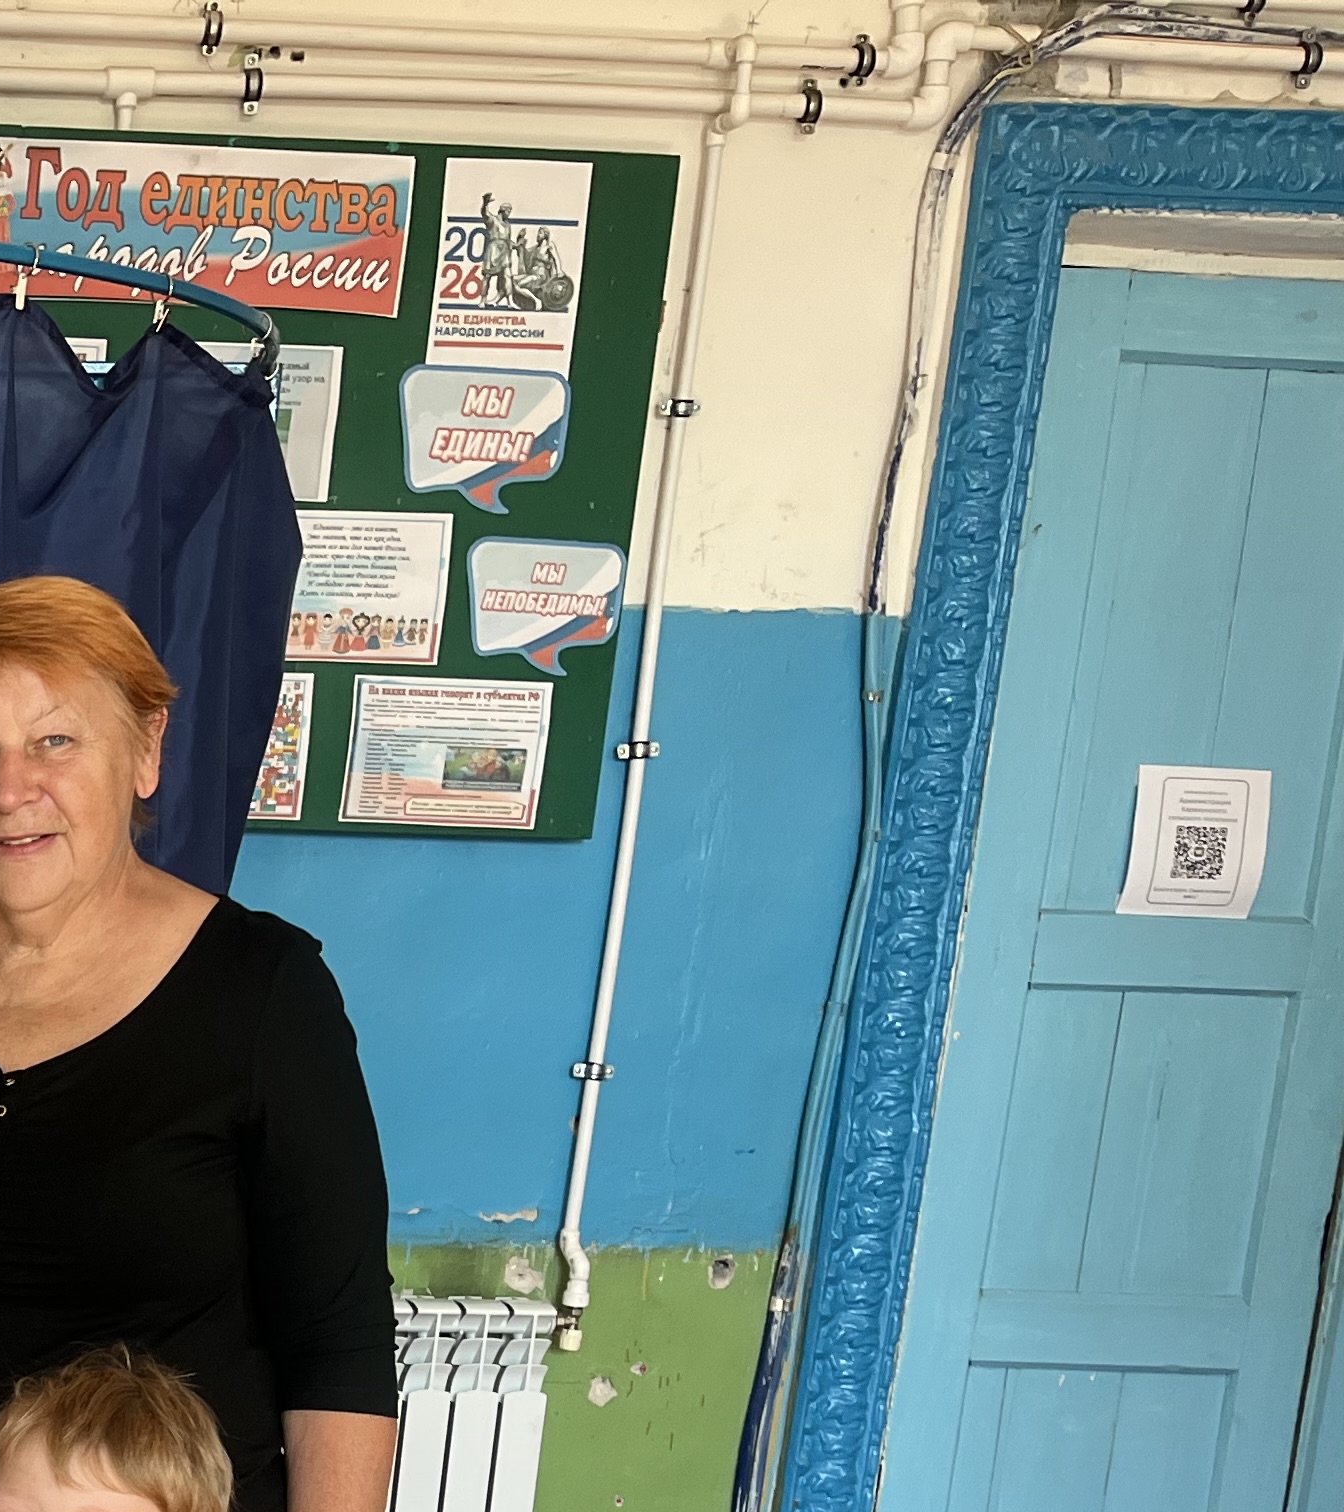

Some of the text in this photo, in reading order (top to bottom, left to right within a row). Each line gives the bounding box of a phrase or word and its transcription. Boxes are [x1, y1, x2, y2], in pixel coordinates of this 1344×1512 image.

[20, 146, 399, 238] Год единства
[224, 225, 391, 292] России
[443, 226, 489, 262] 20
[439, 264, 483, 300] 26
[434, 325, 545, 339] НАРОДОВ РОССИИ
[435, 313, 527, 327] ГОД ЕДИНСТВА
[462, 385, 514, 418] МЫ
[429, 428, 534, 463] ЕДИНЫ!
[531, 562, 567, 585] МЫ
[480, 590, 608, 617] НЕПОБЕДИМЫ!
